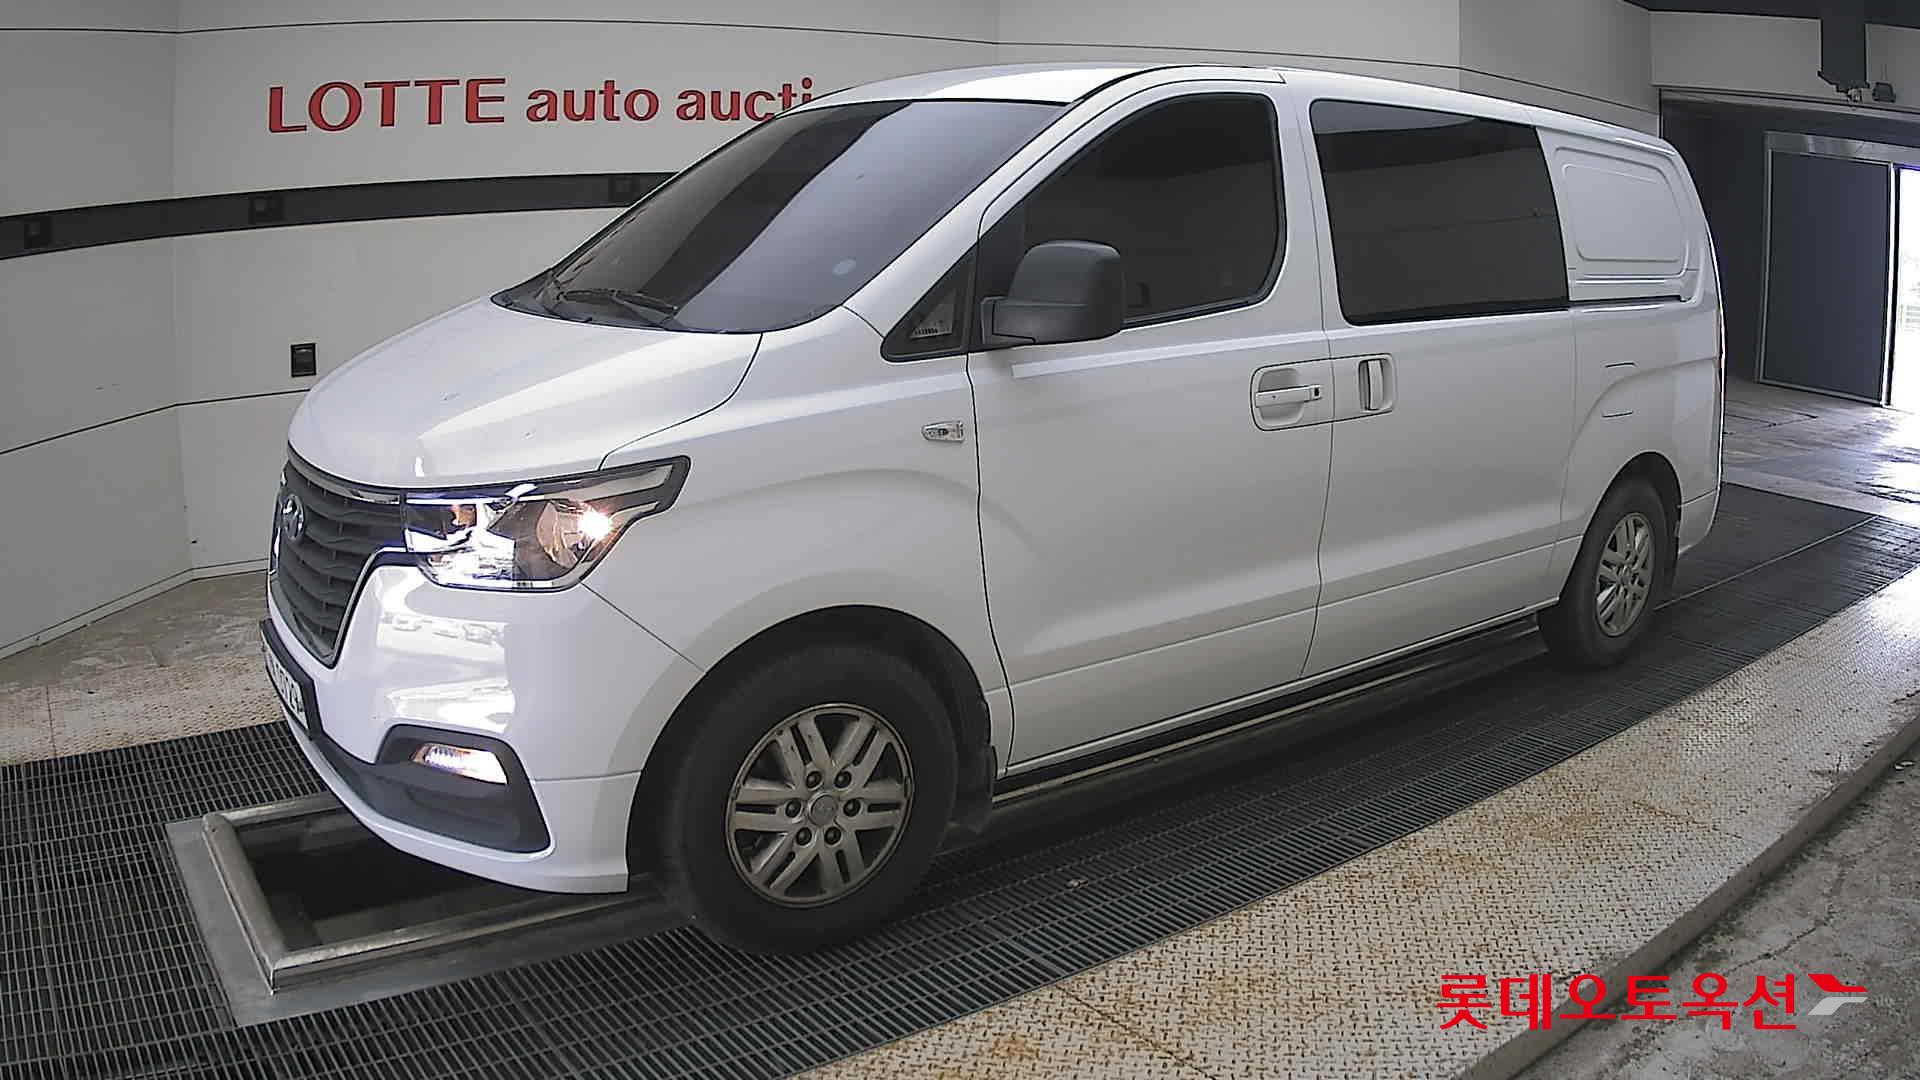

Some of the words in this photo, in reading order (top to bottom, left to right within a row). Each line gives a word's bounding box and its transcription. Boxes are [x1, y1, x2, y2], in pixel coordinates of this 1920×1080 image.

[269, 79, 505, 132] LOTTE
[526, 80, 657, 122] auto
[675, 78, 813, 122] aucti
